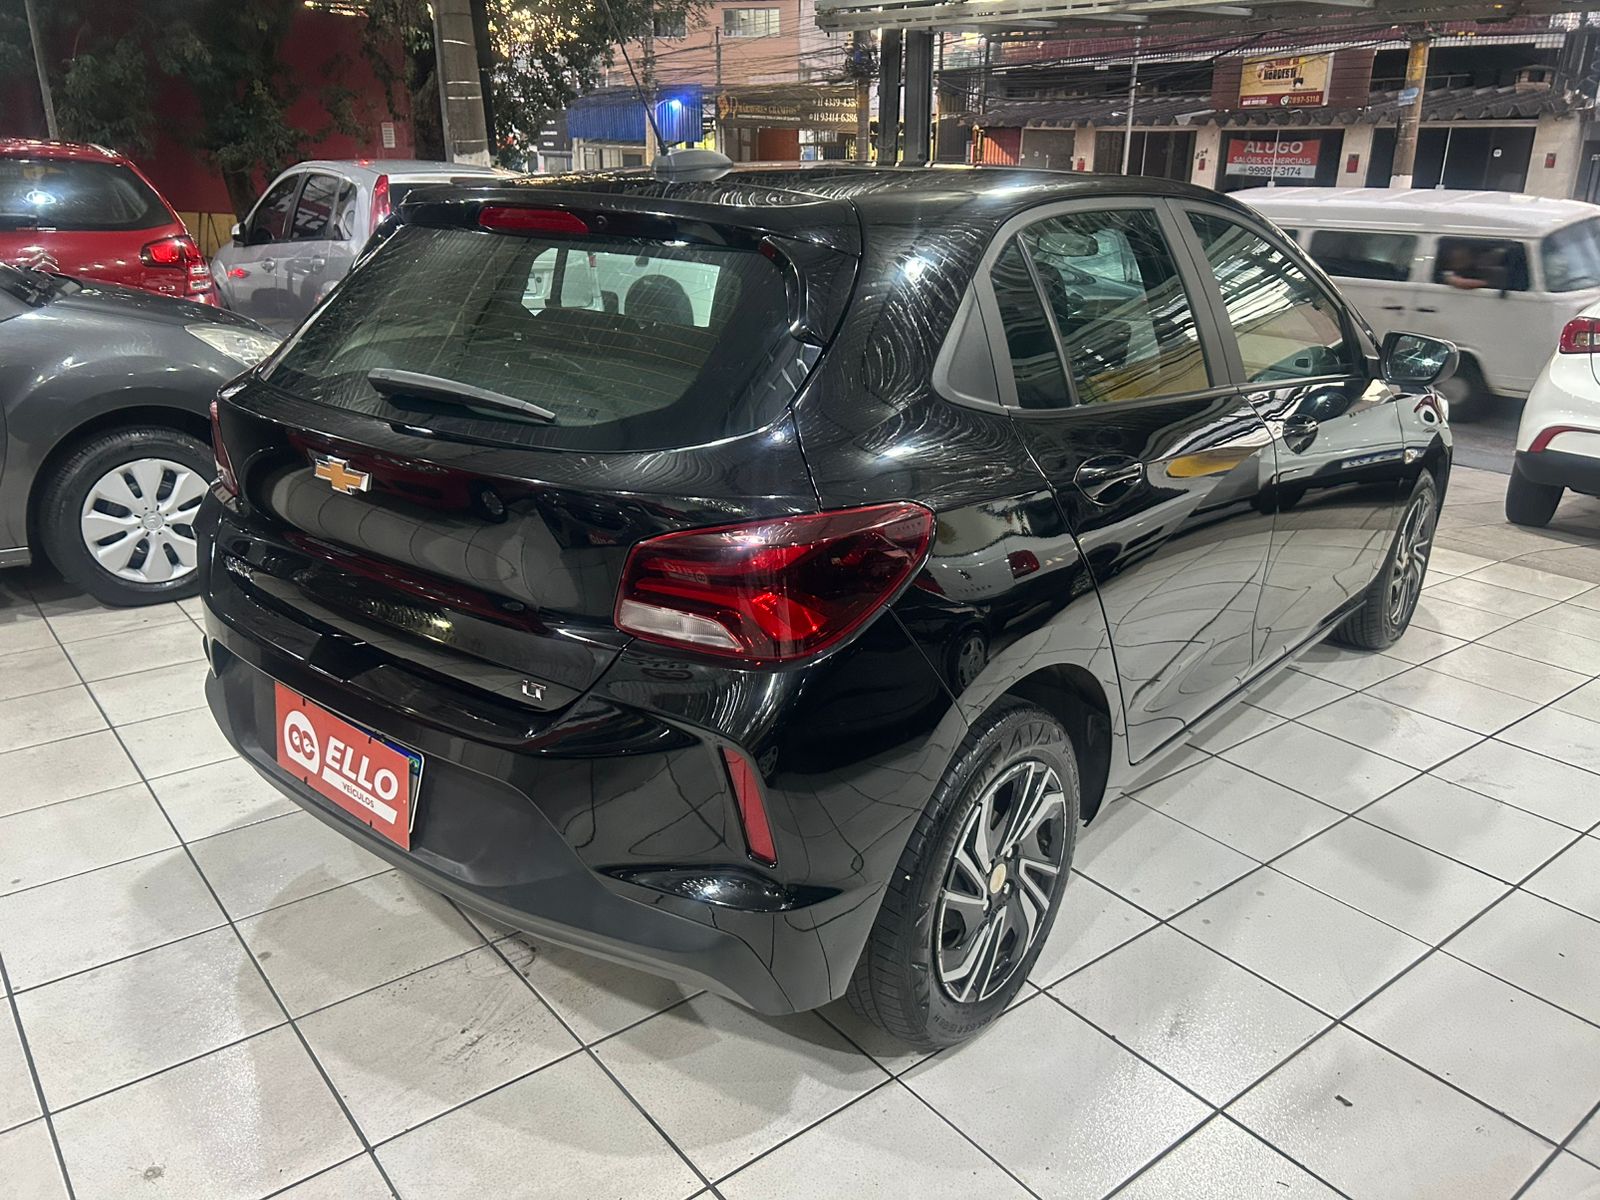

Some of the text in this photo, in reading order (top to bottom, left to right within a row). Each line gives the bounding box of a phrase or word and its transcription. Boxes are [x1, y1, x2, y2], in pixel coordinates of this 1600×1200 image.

[1243, 140, 1303, 154] ALUGO
[1262, 156, 1312, 165] COMERCIAIS
[521, 679, 548, 701] LT
[325, 736, 399, 801] ELLO
